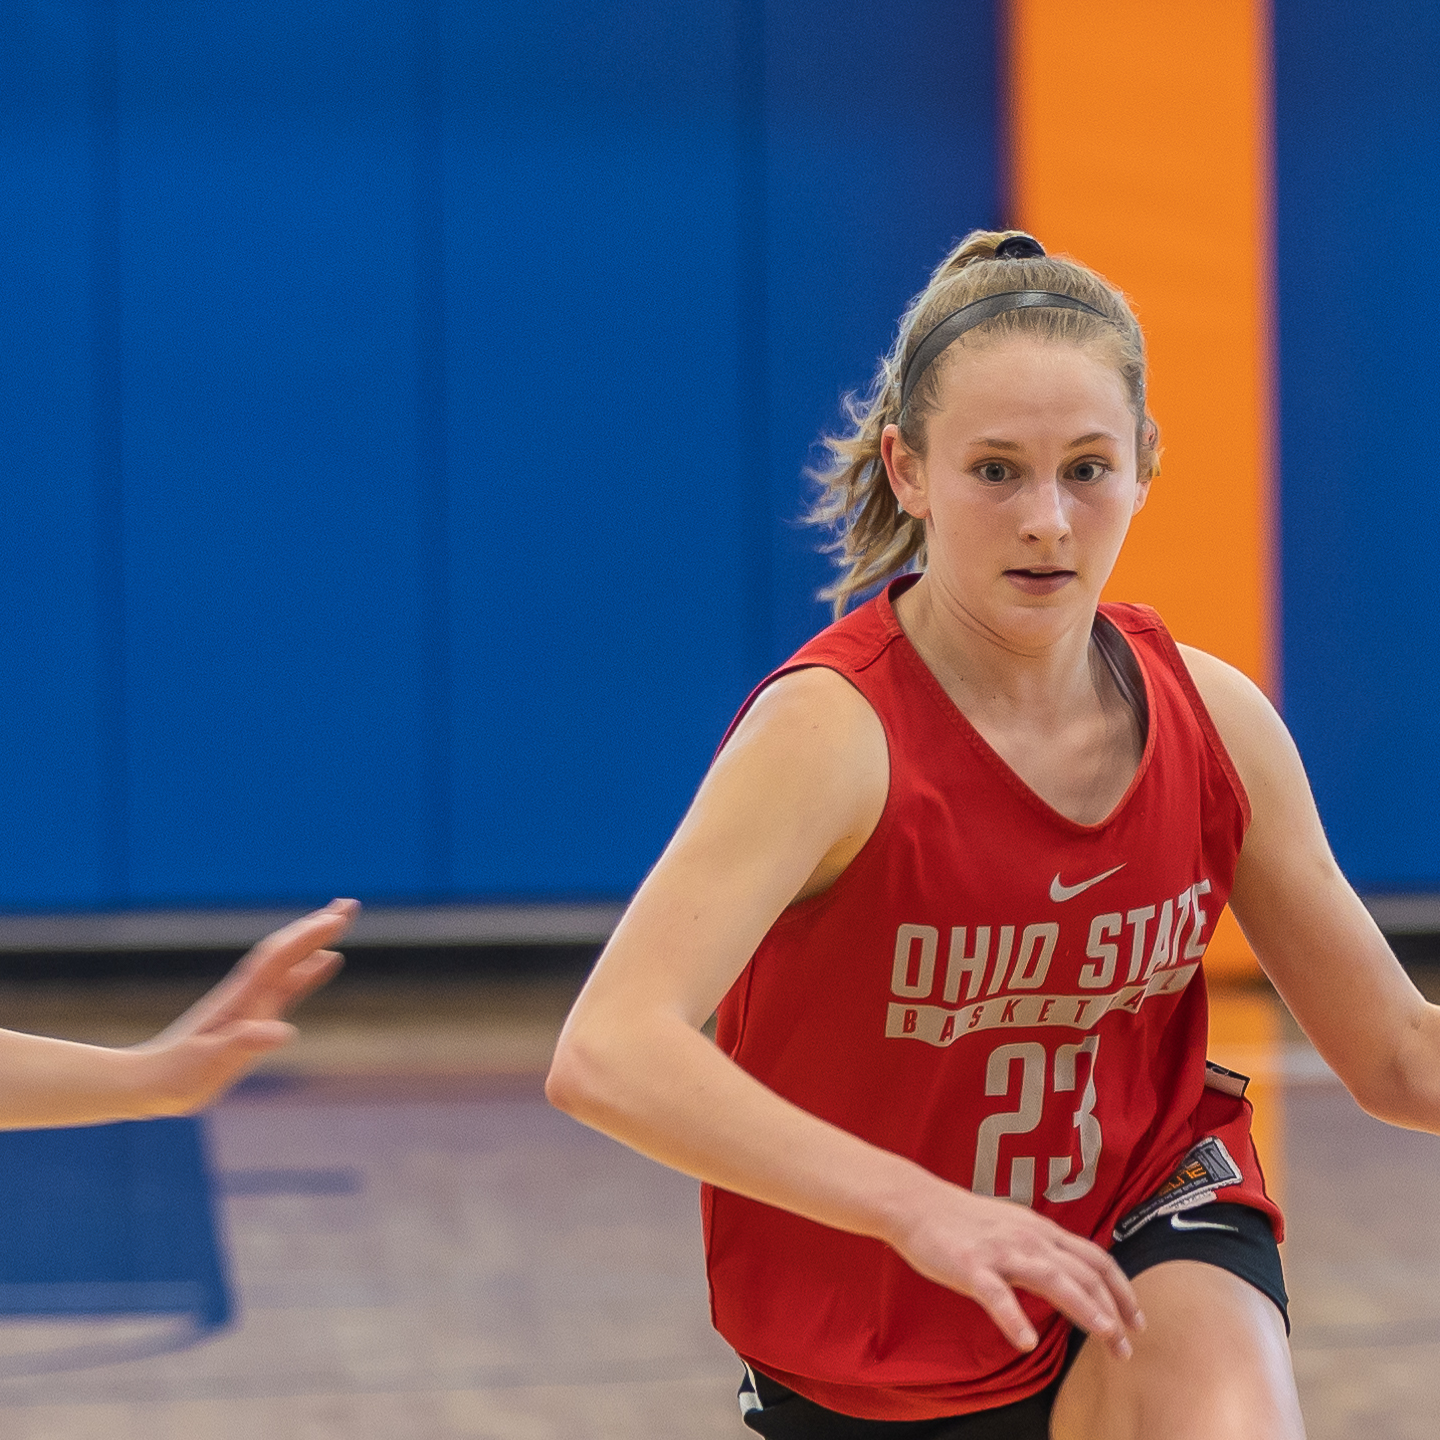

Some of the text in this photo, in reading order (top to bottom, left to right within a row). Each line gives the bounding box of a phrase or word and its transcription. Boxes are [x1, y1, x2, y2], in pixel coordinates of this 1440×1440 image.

[890, 878, 1212, 1004] OHIO STATE
[971, 1033, 1103, 1208] 23
